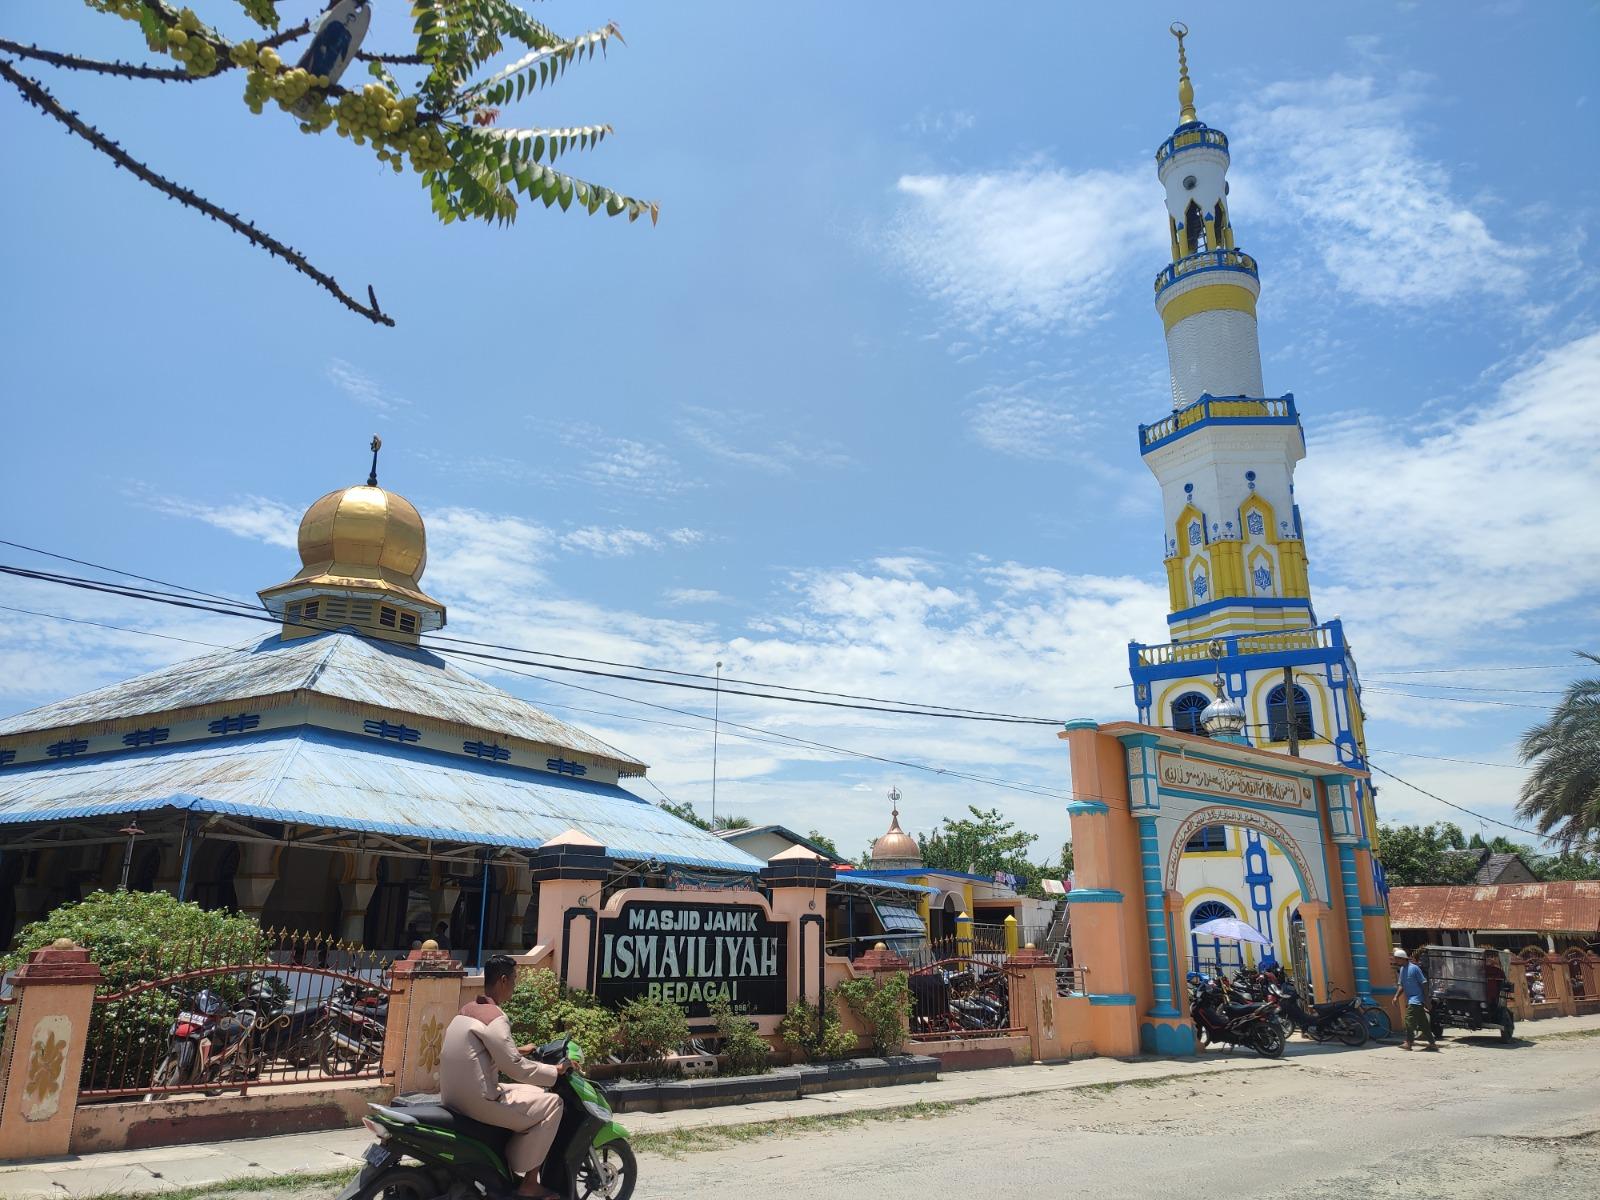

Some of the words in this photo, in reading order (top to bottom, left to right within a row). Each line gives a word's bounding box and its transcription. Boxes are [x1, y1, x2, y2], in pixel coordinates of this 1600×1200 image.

[629, 908, 701, 931] MASJID
[703, 910, 758, 931] JAMIK
[601, 934, 779, 978] ISMA'ILIYAH
[648, 981, 737, 1003] BEDAGAI
